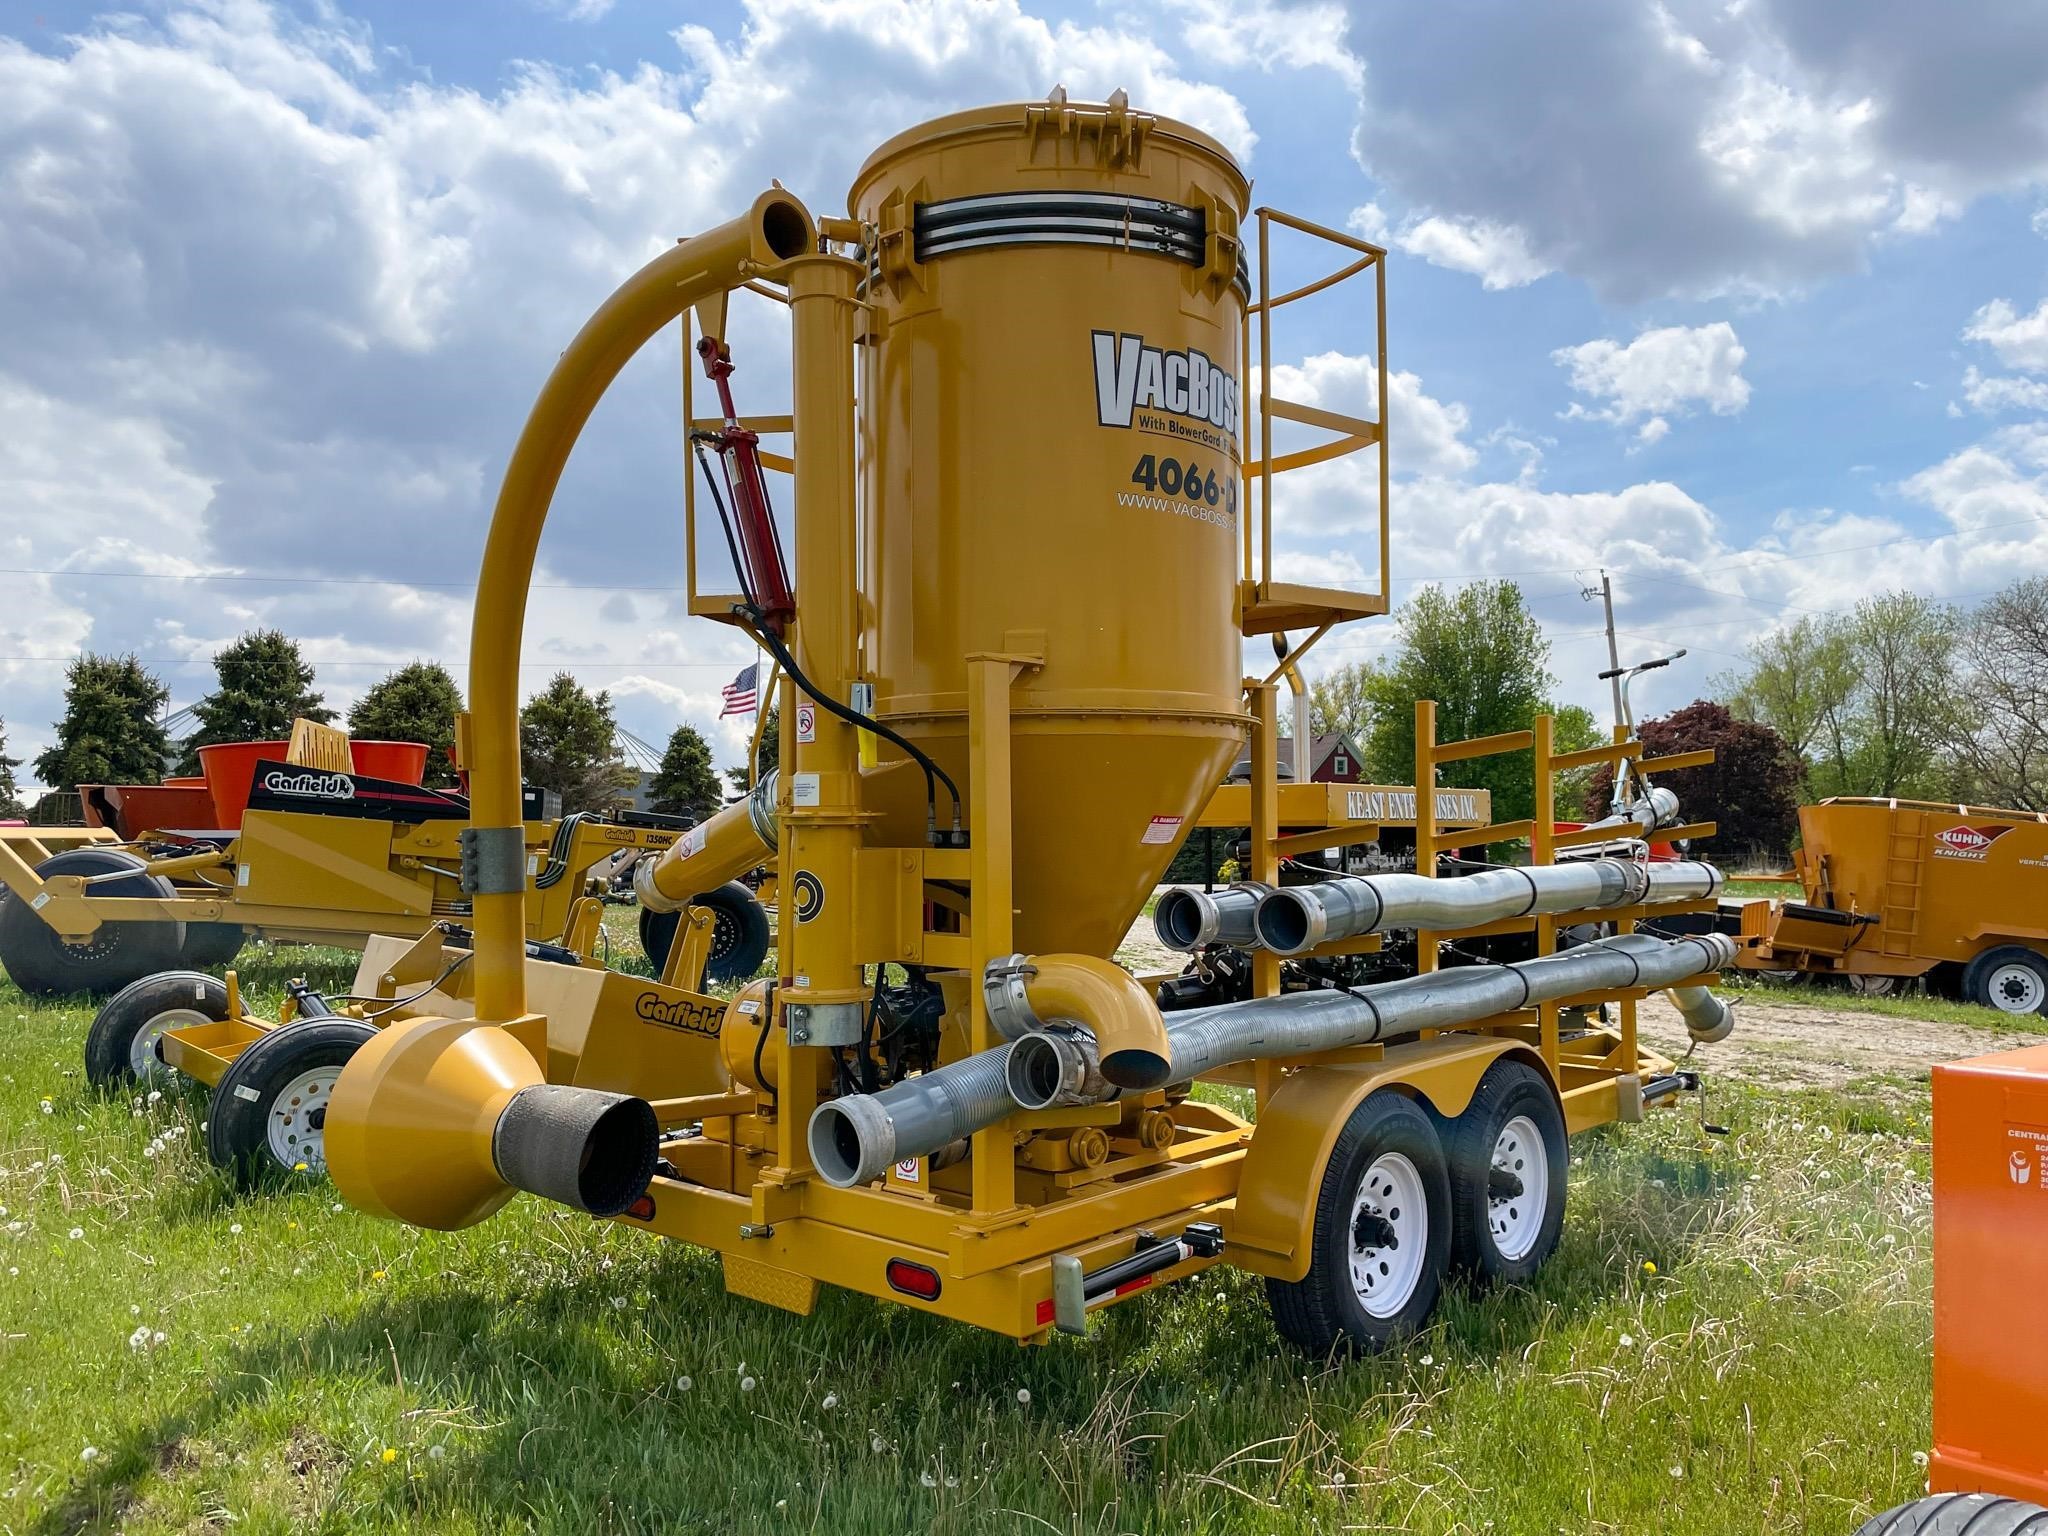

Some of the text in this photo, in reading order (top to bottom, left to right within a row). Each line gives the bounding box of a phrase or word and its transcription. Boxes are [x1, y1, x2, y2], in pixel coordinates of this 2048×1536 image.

[1138, 414, 1221, 448] With BlowerGard
[265, 772, 341, 795] Garfield
[1347, 791, 1479, 820] KEAST ENTEISES INC.
[646, 834, 672, 845] 1350HC
[1942, 832, 1983, 845] KUHN
[1934, 848, 1987, 860] KNIGHT
[2018, 858, 2048, 867] VERTIC
[636, 992, 724, 1035] Garfield
